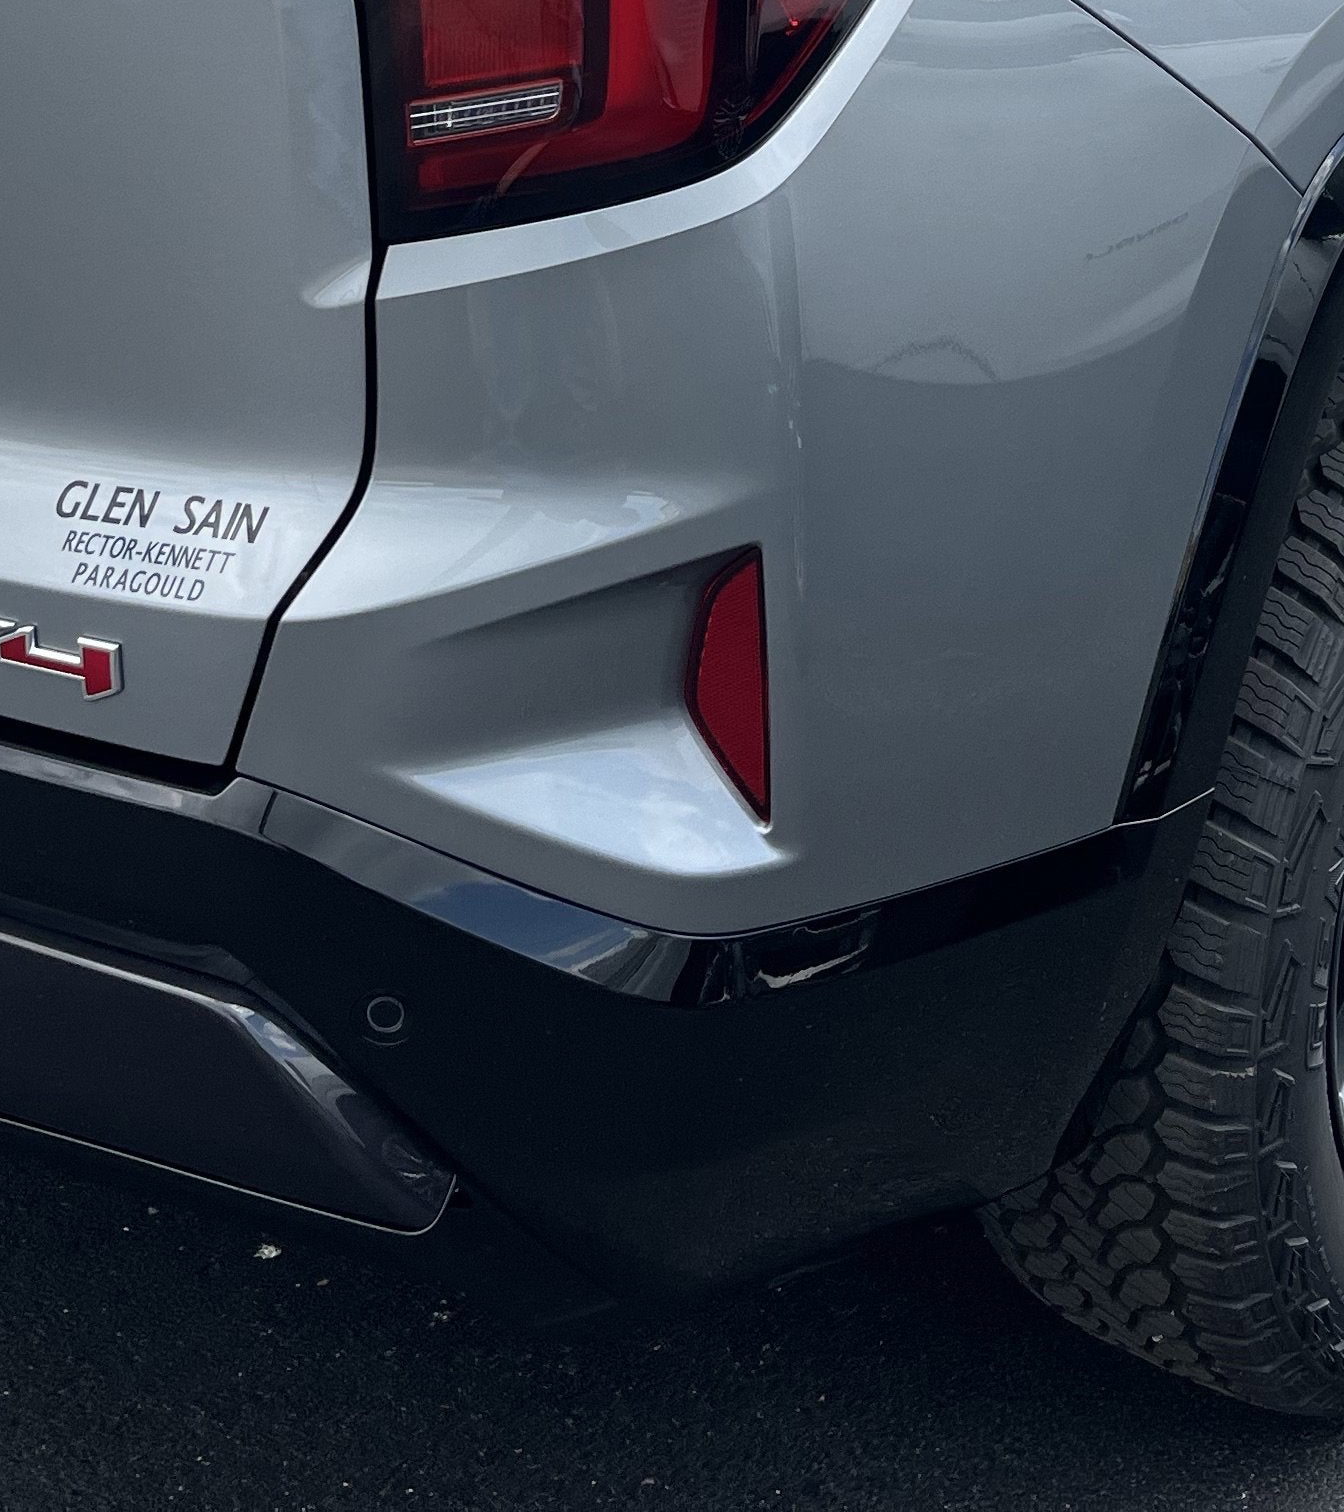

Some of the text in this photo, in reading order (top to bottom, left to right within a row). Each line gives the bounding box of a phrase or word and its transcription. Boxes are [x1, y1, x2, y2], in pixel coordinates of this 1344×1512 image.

[56, 479, 270, 544] GLEN SAIN
[61, 529, 237, 575] RECTOR-KENNETT
[70, 561, 206, 603] PARAGOULD
